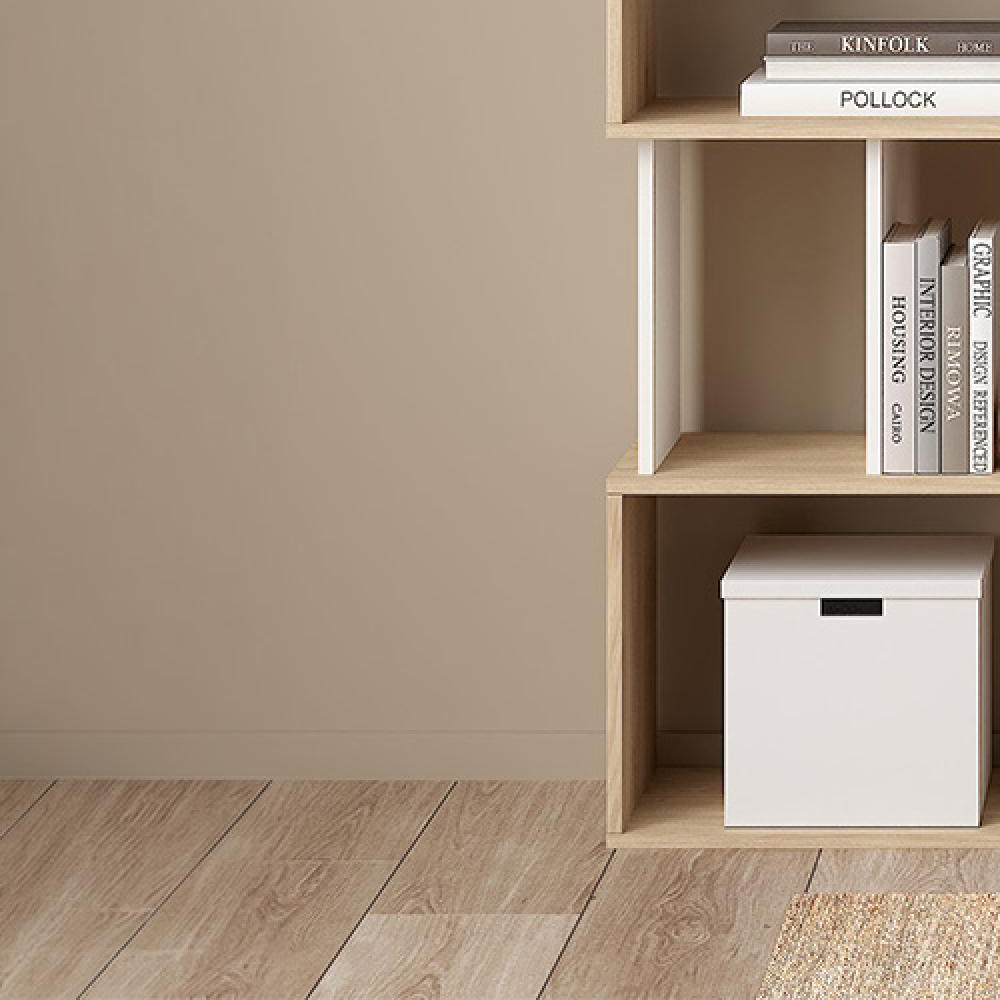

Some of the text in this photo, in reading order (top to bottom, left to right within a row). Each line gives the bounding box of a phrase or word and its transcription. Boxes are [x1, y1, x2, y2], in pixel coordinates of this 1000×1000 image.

[841, 35, 930, 54] KINFOLK
[957, 41, 994, 53] HOME
[840, 90, 937, 108] POLLOCK
[973, 243, 993, 319] GRAPHIC
[891, 295, 907, 385] HOUSING
[919, 277, 937, 433] INTERIOR DESIGN
[947, 326, 961, 422] RIMOWA
[891, 402, 903, 445] CAIRO
[973, 389, 988, 473] REFERENCED
